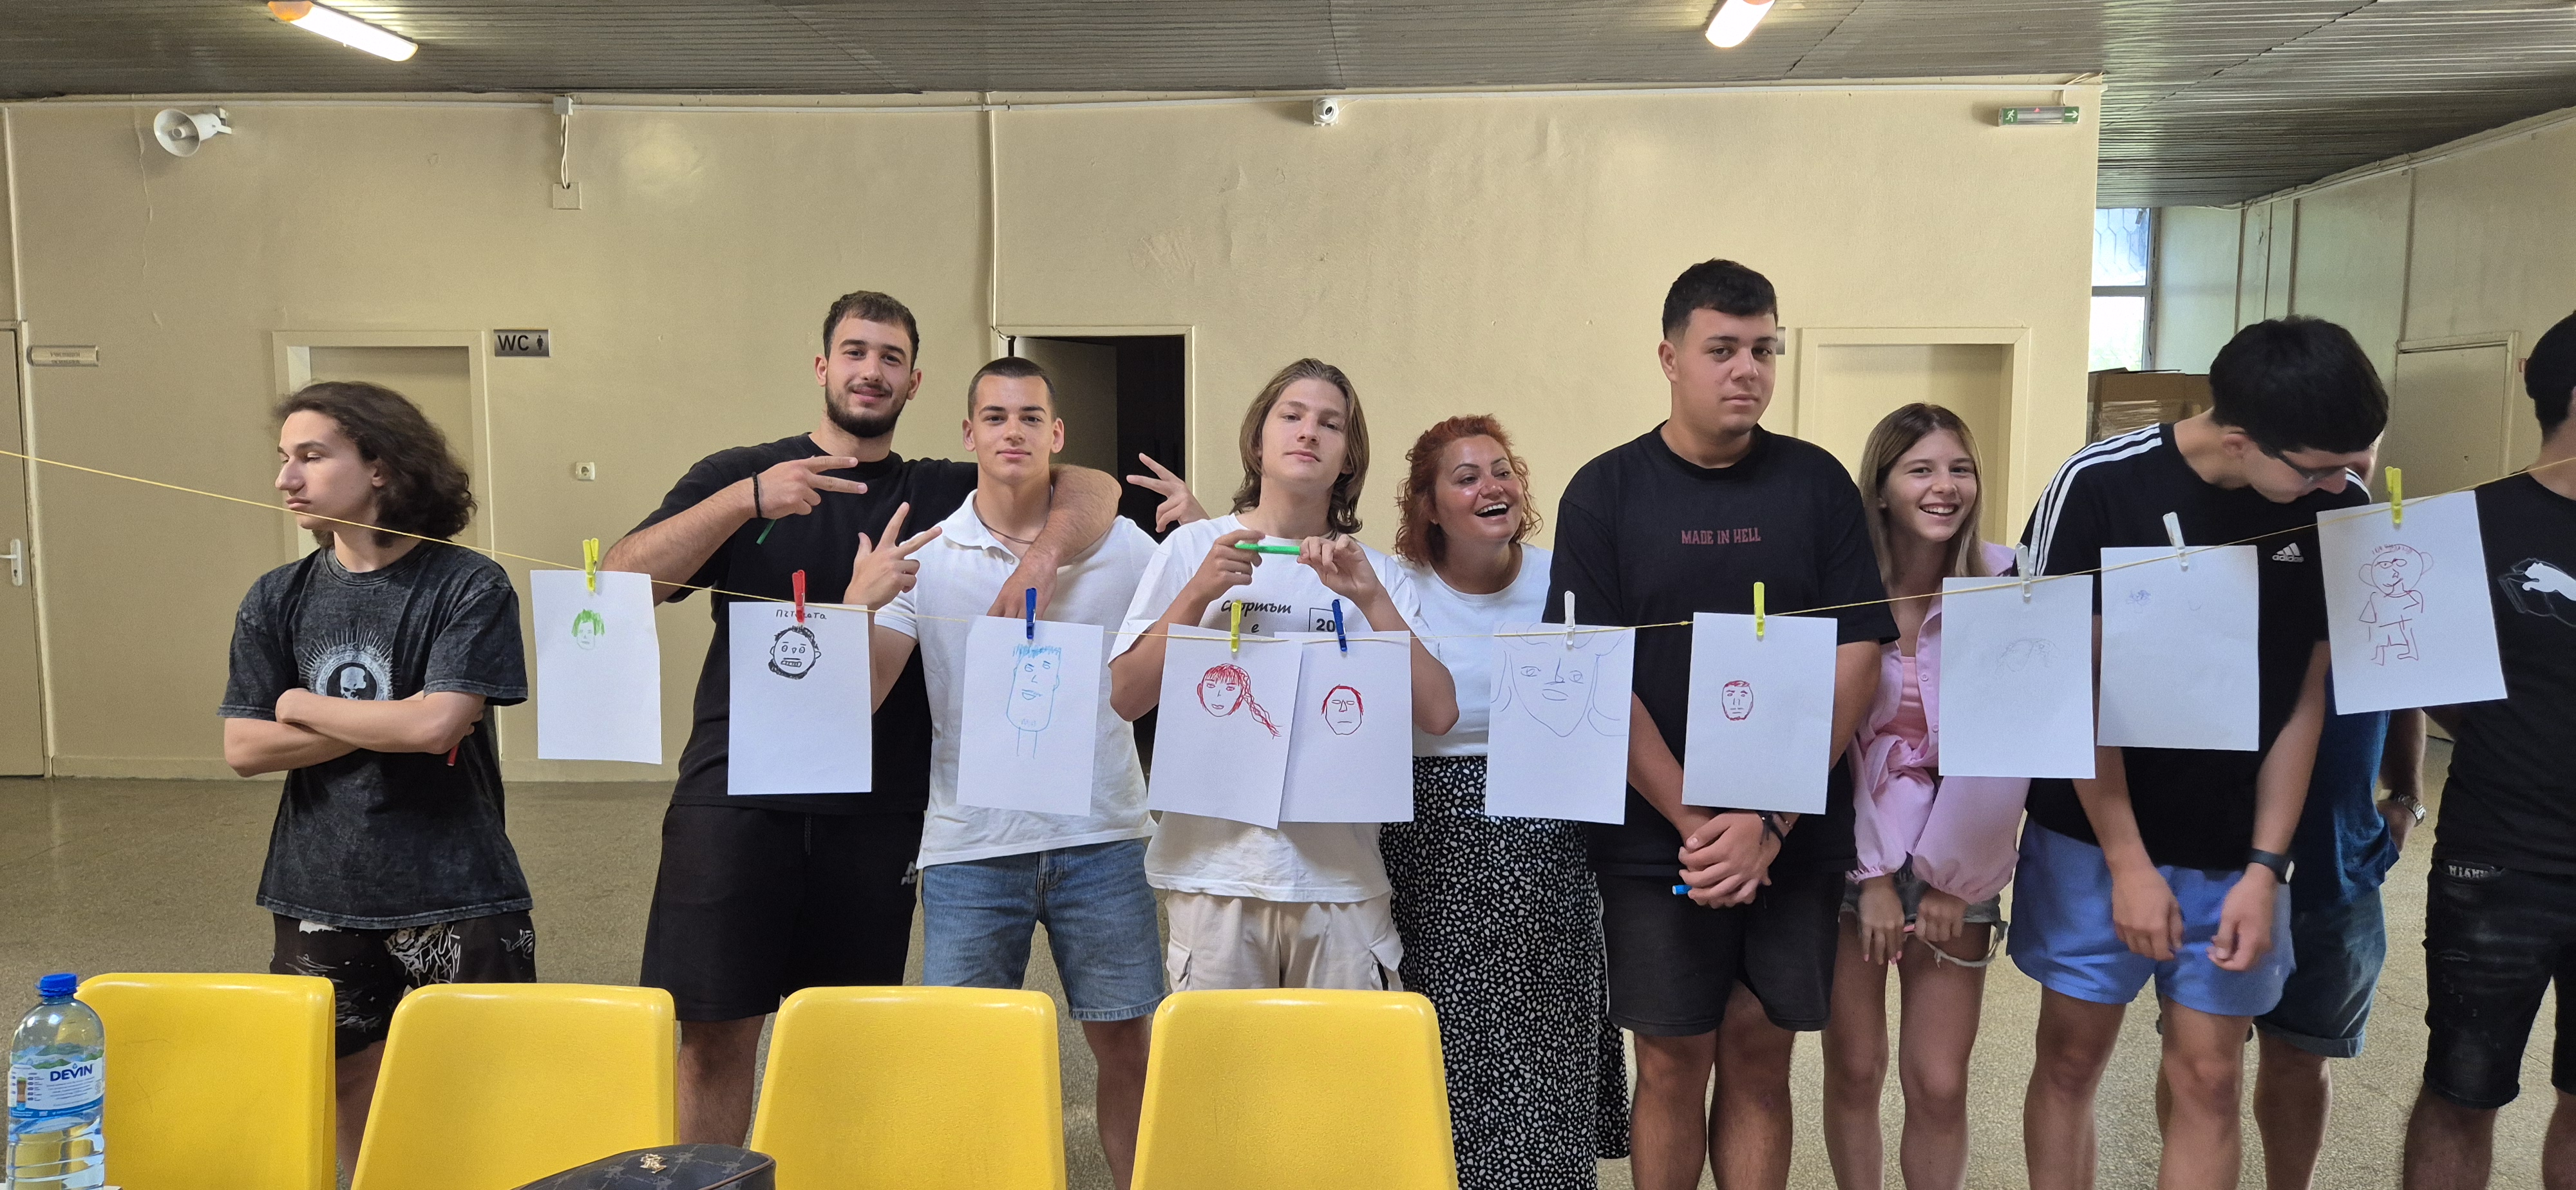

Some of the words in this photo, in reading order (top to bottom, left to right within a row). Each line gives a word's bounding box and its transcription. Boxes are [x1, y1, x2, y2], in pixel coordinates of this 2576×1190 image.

[497, 334, 529, 351] WC
[1681, 529, 1714, 545] MADE
[1717, 529, 1730, 545] IN
[1733, 527, 1762, 543] HELL
[1220, 600, 1292, 617] Сортът
[1316, 618, 1336, 633] 20
[50, 1064, 93, 1082] DEVIN
